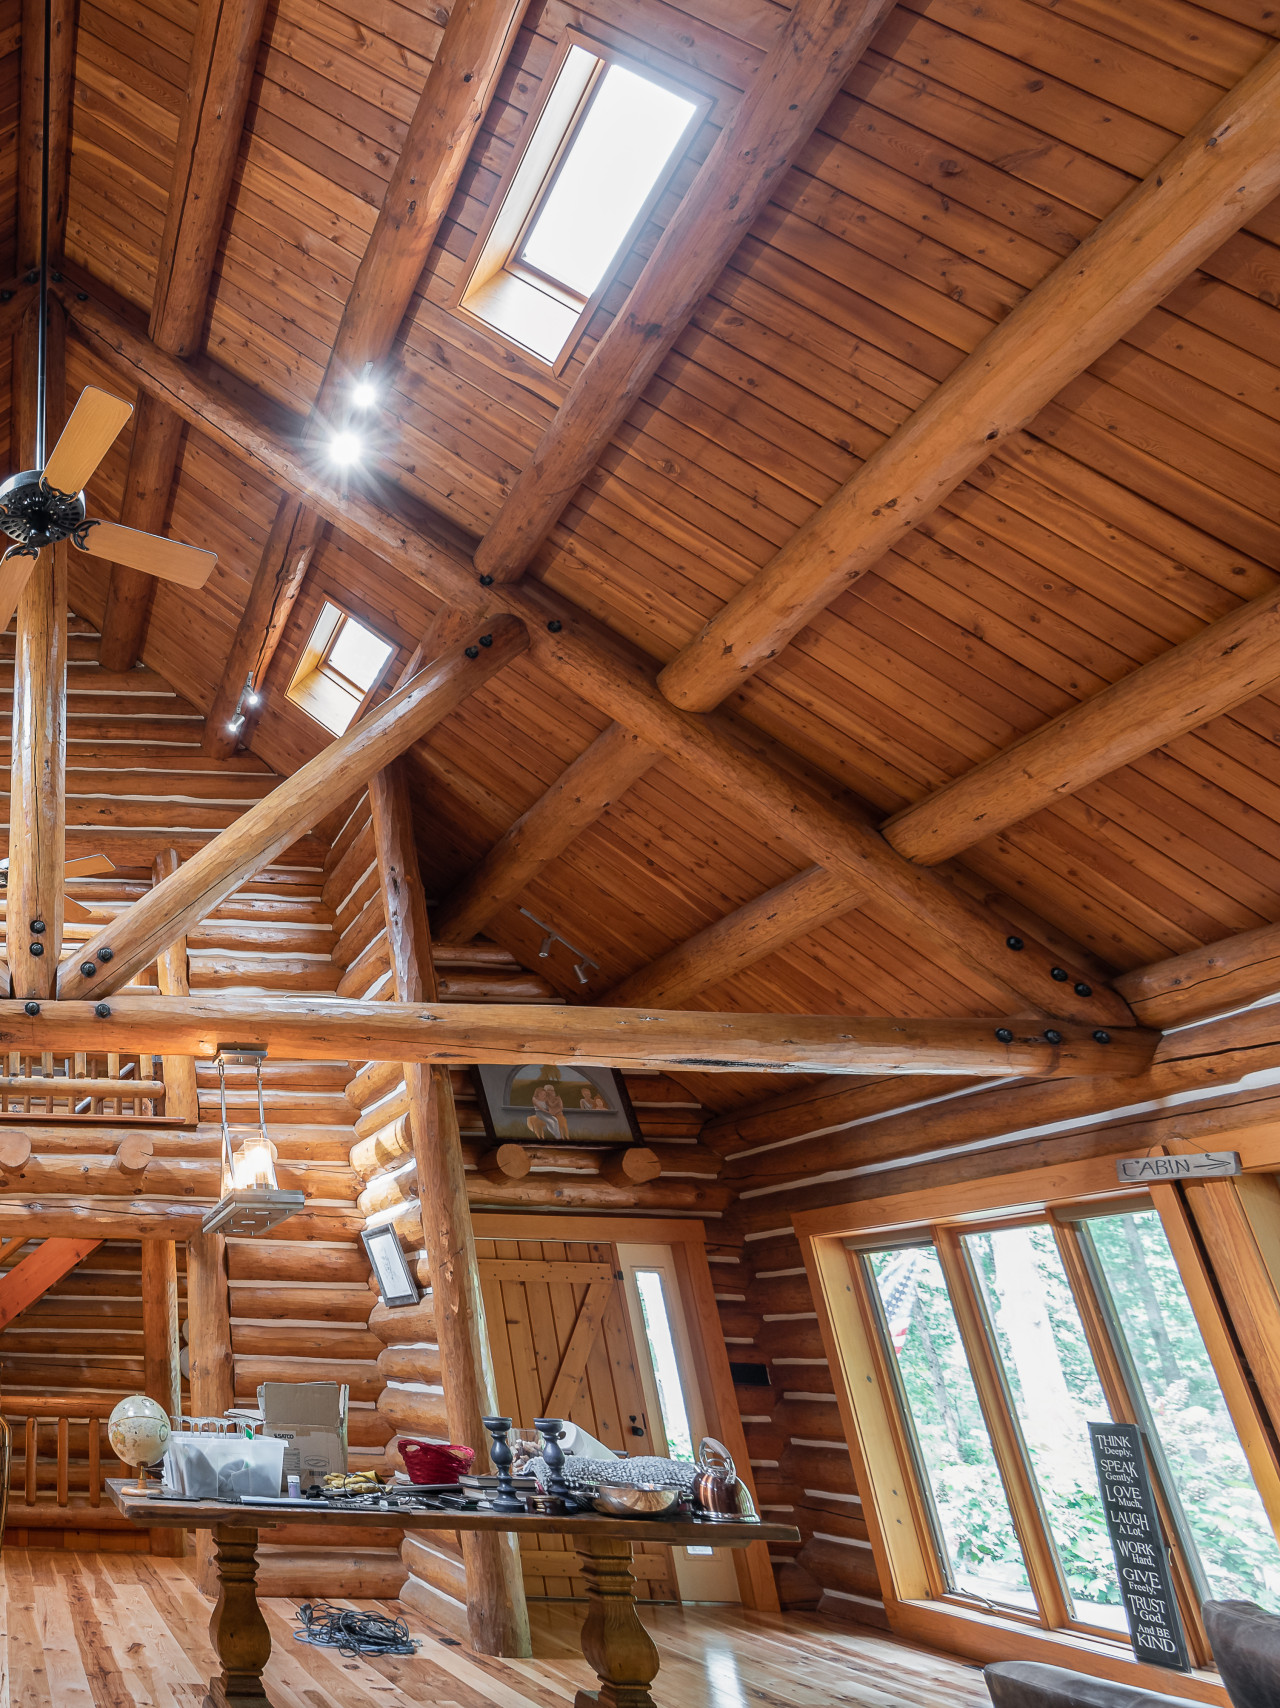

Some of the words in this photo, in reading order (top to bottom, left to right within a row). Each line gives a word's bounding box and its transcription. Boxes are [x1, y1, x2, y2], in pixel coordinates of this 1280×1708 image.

[1122, 1159, 1189, 1177] CABIN
[1095, 1434, 1131, 1450] THINK
[1104, 1447, 1133, 1457] Deeply,
[1100, 1460, 1138, 1478] SPEAK
[1105, 1473, 1134, 1483] Gently,
[1105, 1485, 1141, 1502] LOVE
[1118, 1498, 1143, 1509] Much,
[1111, 1510, 1149, 1531] LAUGH
[1119, 1525, 1126, 1534] A
[1127, 1526, 1143, 1537] Lot,
[1117, 1539, 1155, 1558] WORK
[1132, 1554, 1155, 1567] Hard,
[1122, 1567, 1161, 1589] GIVE
[1129, 1581, 1156, 1595] Freely,
[1128, 1594, 1165, 1615] TRUST
[1139, 1610, 1165, 1625] God,
[1138, 1624, 1155, 1634] And
[1157, 1627, 1170, 1638] BE
[1137, 1633, 1176, 1653] KIND
